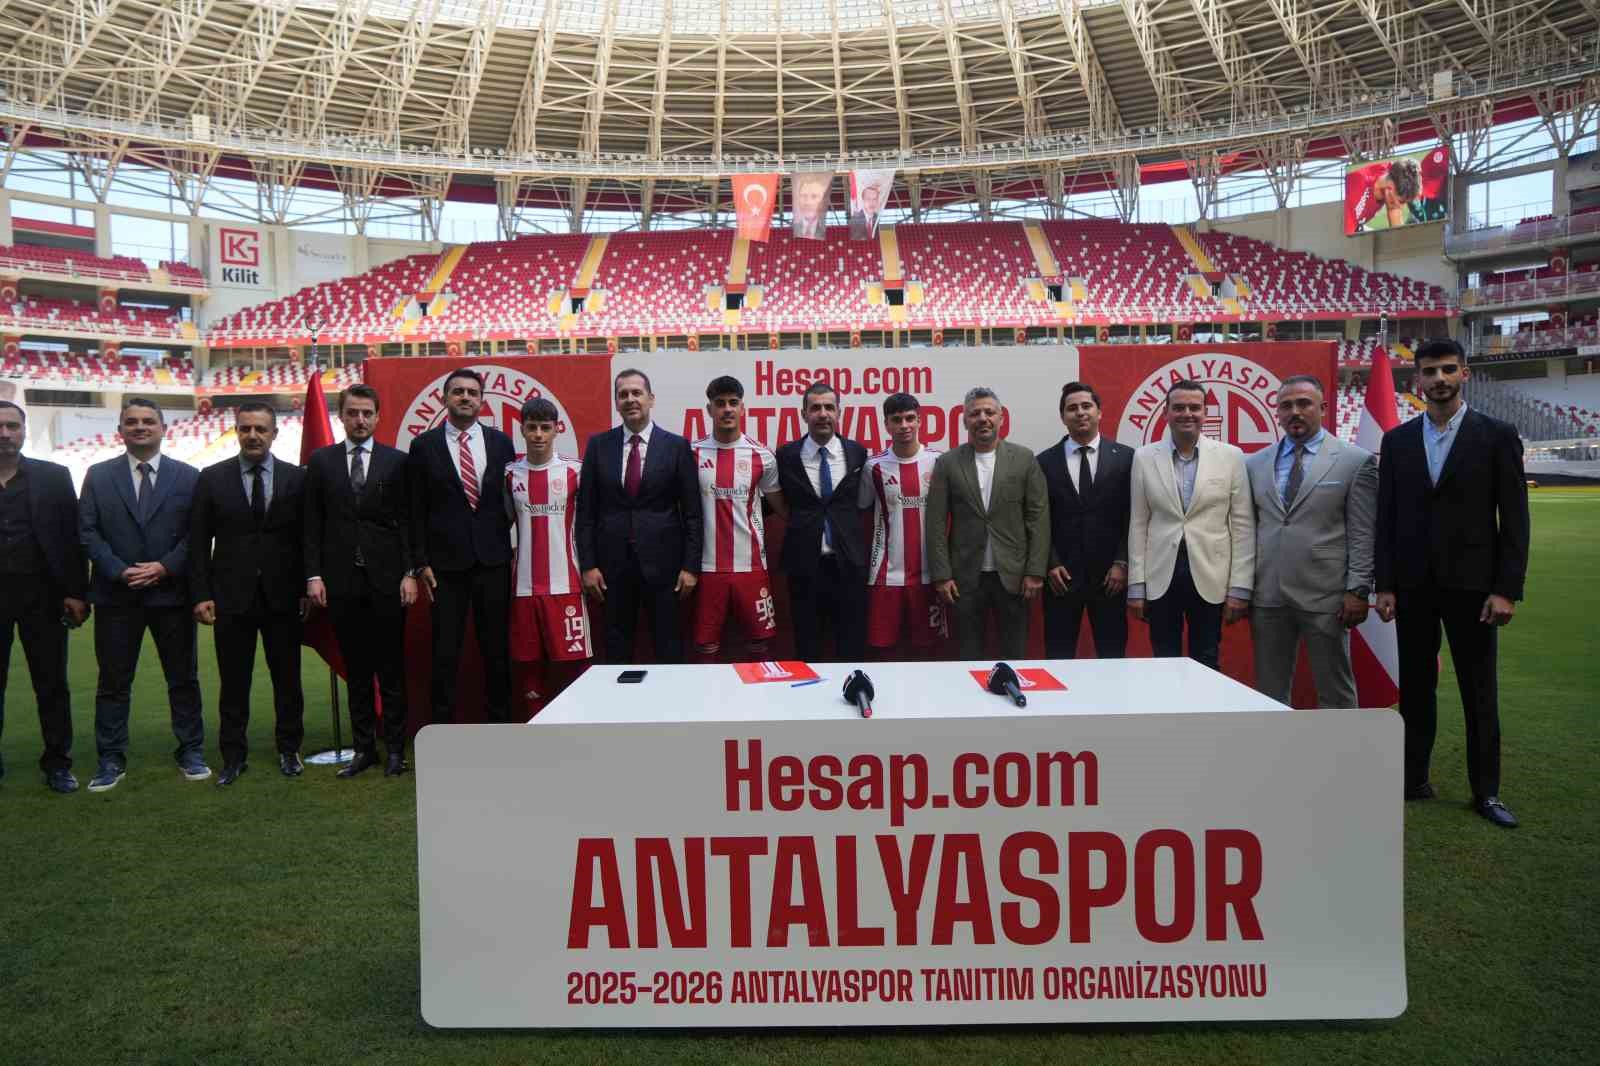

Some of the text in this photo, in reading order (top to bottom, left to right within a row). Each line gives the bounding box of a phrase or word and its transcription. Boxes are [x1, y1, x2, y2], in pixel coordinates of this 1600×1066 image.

[223, 268, 259, 284] Kilit
[755, 360, 933, 403] Hesap.com
[1129, 360, 1280, 430] ANTALYASPO
[564, 616, 584, 640] 19
[725, 739, 1099, 827] Hesap.com
[568, 829, 1265, 950] ANTALYASPOR
[731, 969, 913, 1004] ANTALYASPOR
[921, 967, 1035, 1001] TANITIM
[1043, 961, 1267, 1000] ORGANİZASYONU
